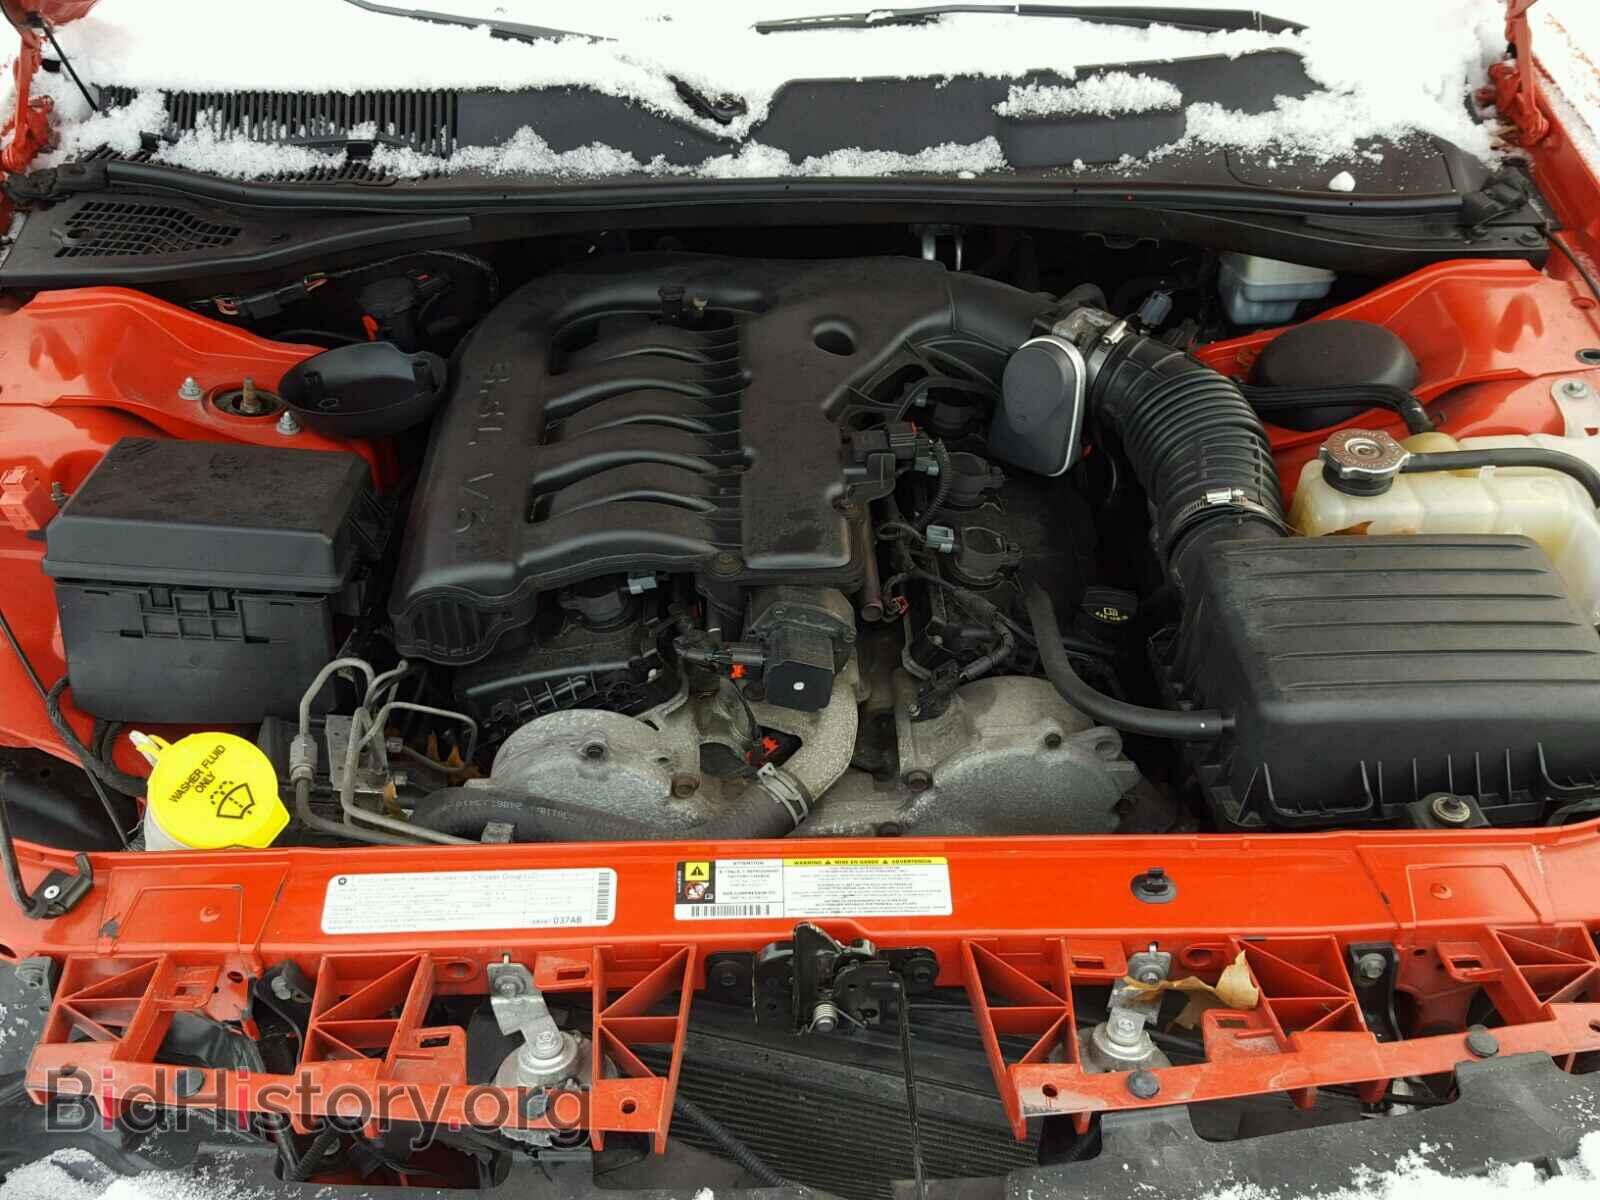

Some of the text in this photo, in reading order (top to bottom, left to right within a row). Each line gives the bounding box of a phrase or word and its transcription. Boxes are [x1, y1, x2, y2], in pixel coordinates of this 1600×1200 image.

[169, 744, 227, 803] WASHER FLUID
[194, 771, 216, 794] ONLY
